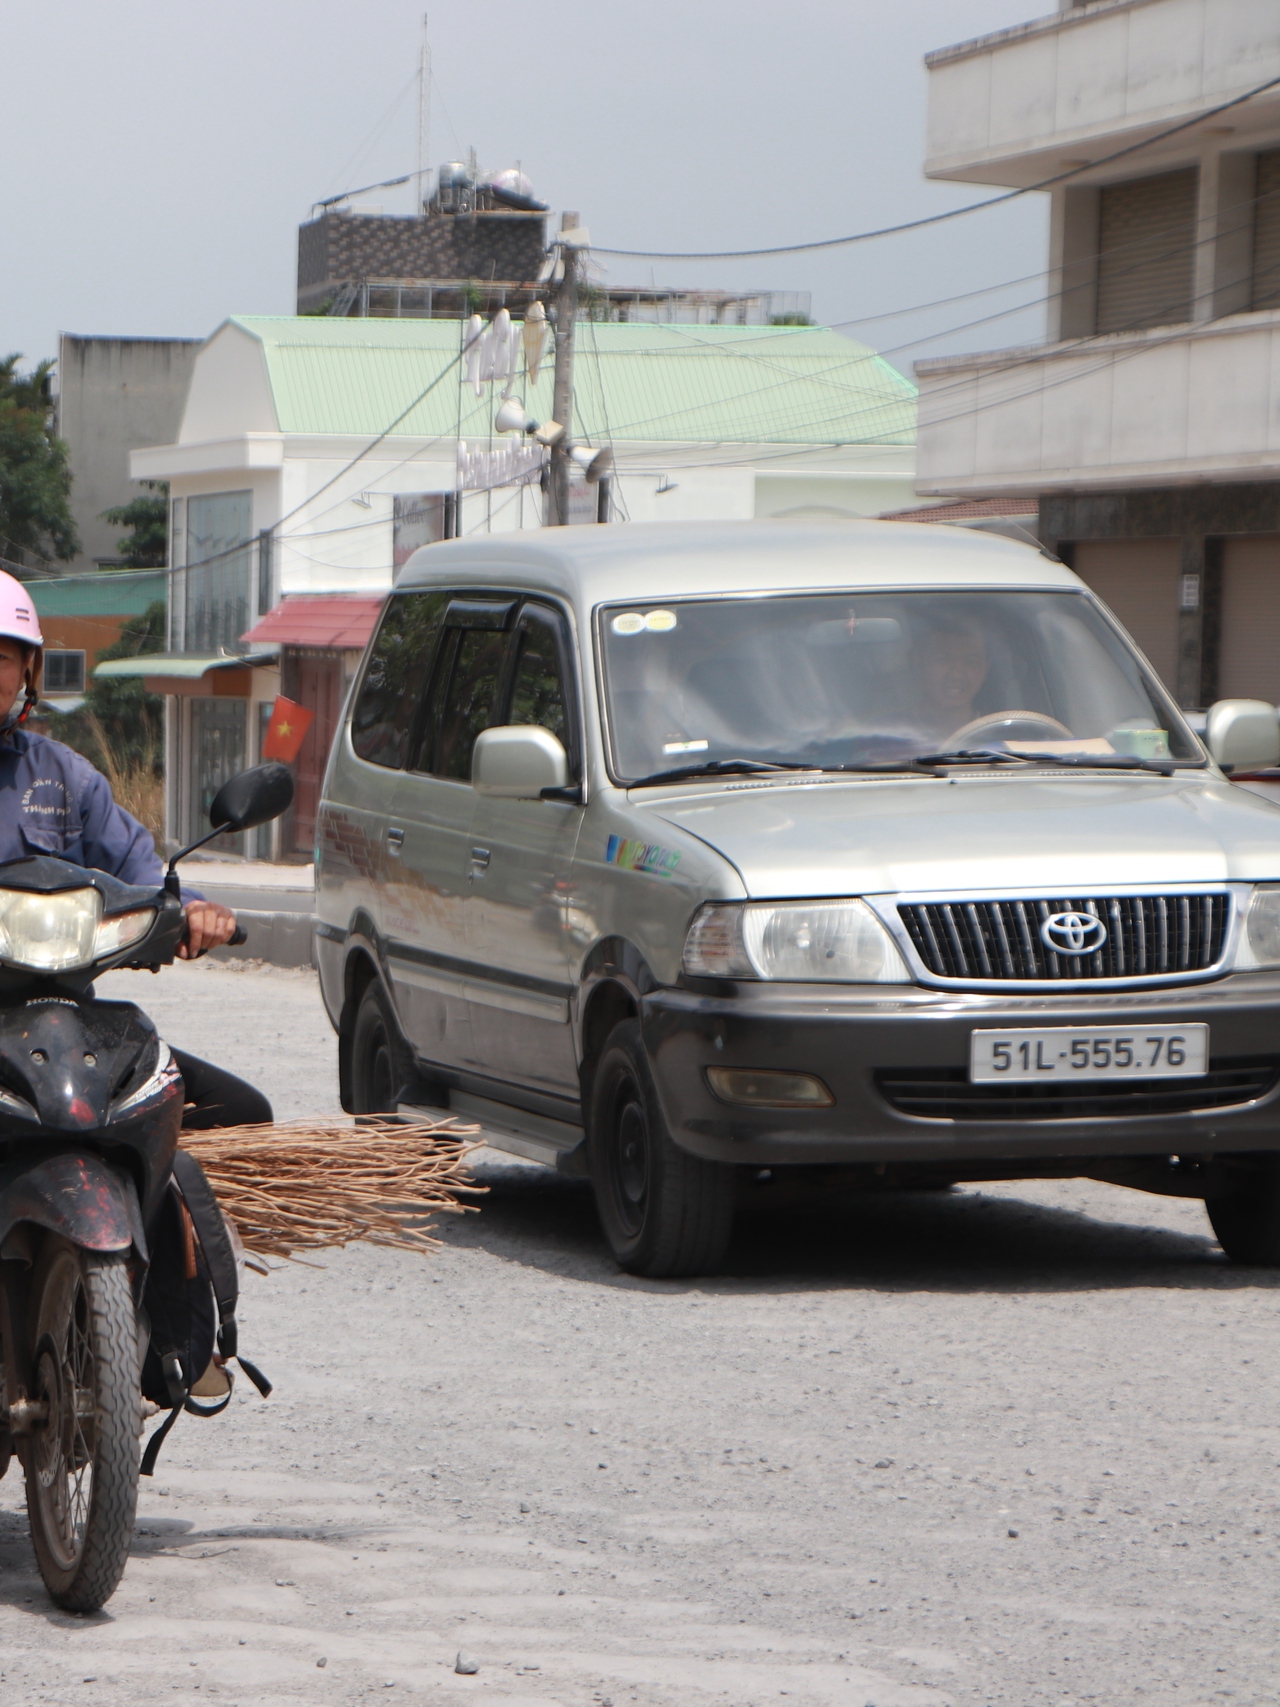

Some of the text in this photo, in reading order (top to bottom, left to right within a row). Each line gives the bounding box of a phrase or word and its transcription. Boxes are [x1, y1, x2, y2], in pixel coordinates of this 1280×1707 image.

[22, 788, 34, 804] BAN
[26, 997, 80, 1007] HONDA
[992, 1036, 1186, 1071] 51L-555.76
